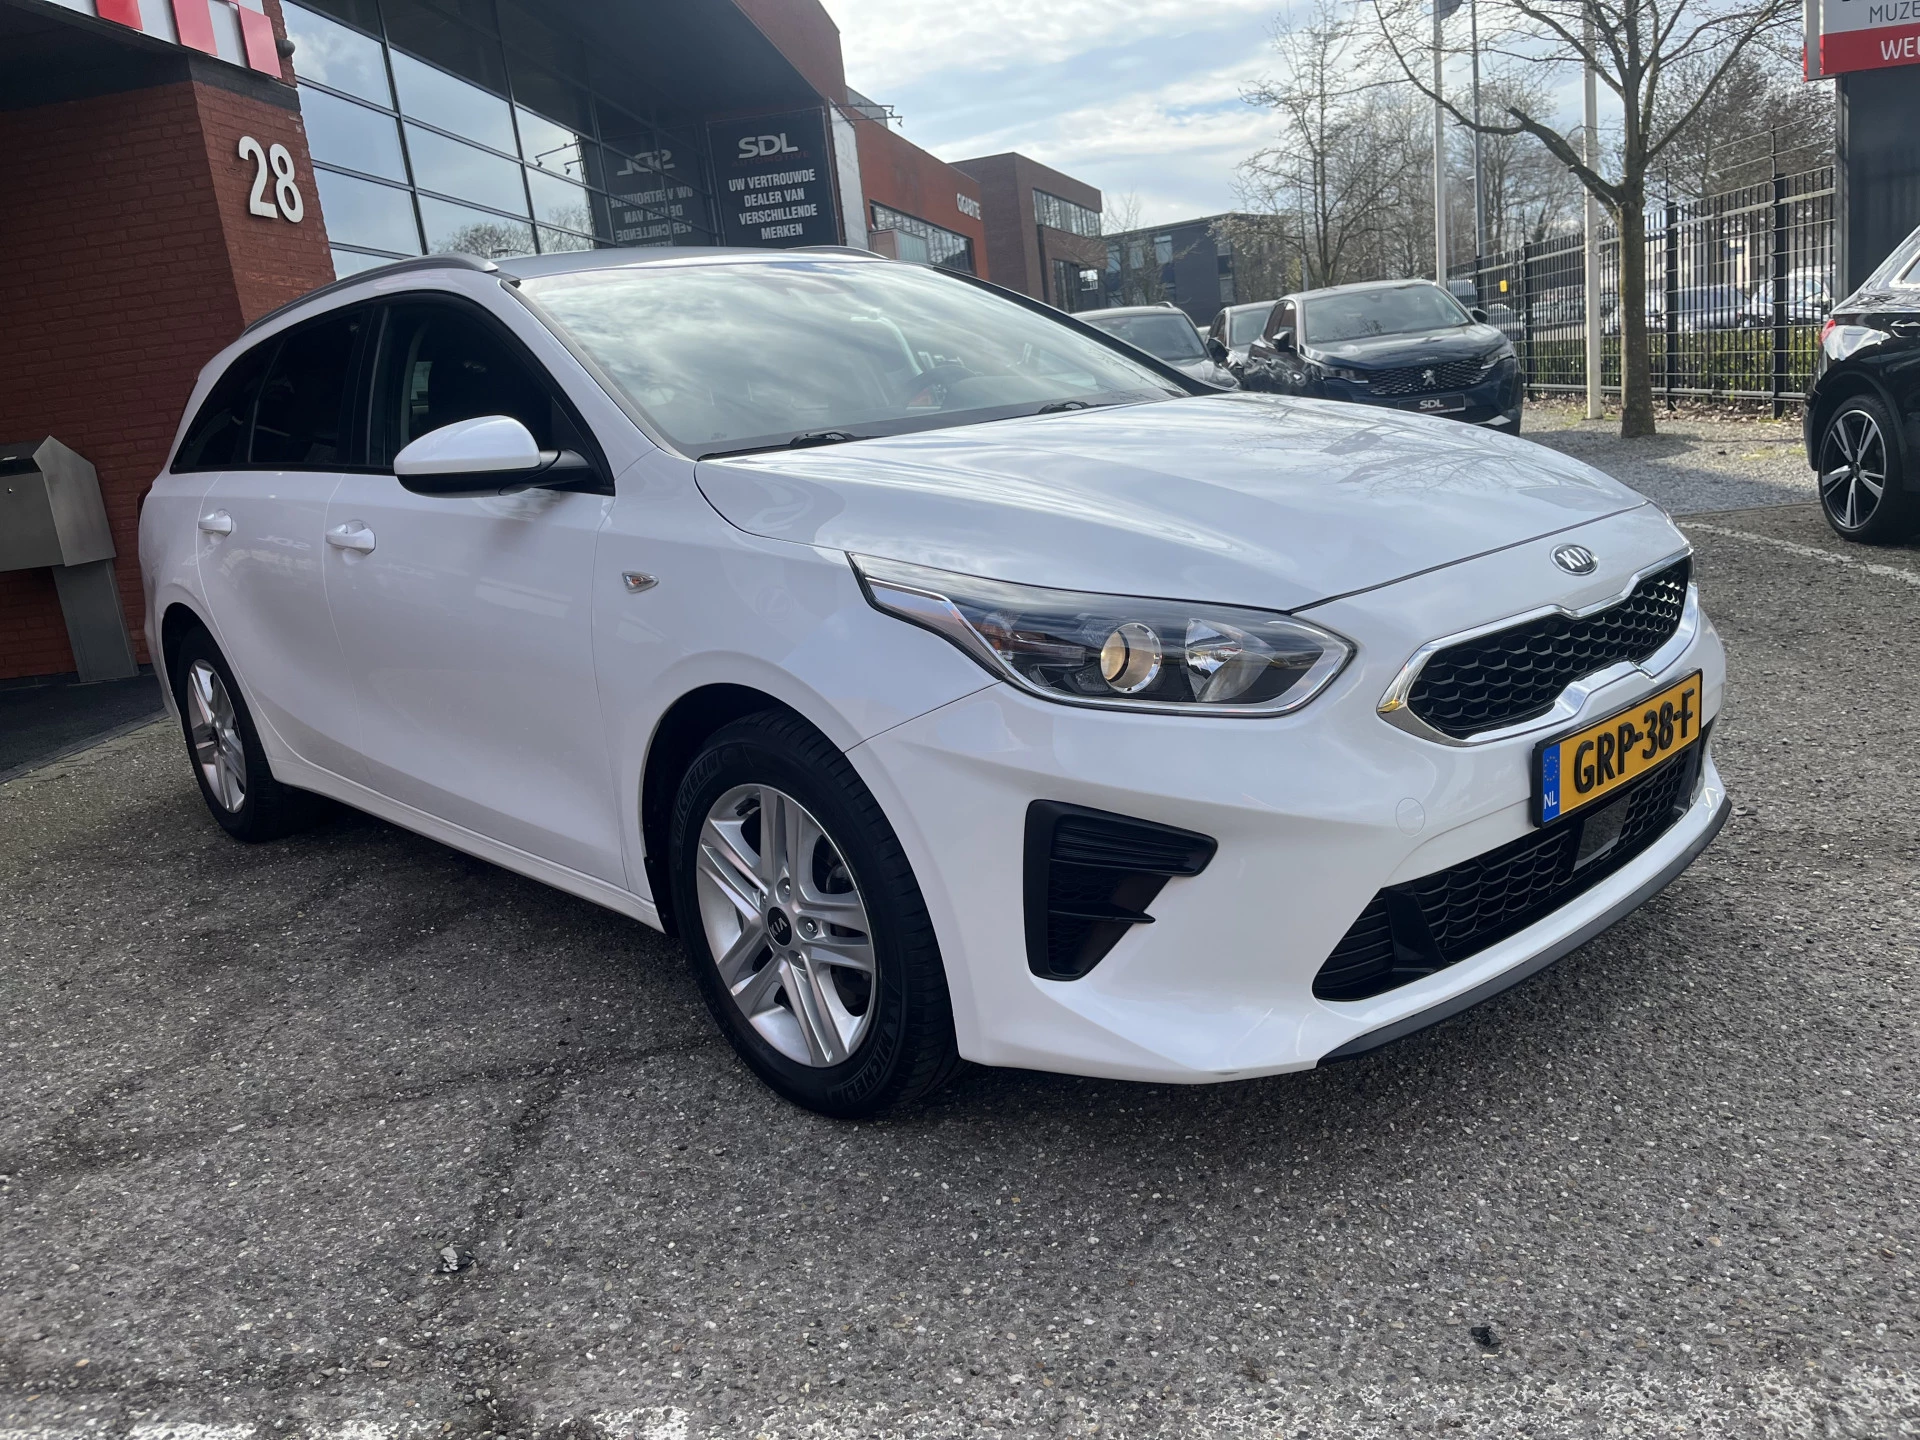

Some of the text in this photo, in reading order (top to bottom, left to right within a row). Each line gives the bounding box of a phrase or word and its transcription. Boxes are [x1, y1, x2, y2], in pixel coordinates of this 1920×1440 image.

[738, 132, 799, 159] SDL
[238, 135, 304, 223] 28
[728, 168, 816, 192] UW VERTROUWDE
[744, 187, 805, 208] DEALER VAN
[739, 203, 818, 225] VERSCHILLENDE
[761, 222, 803, 240] MERKEN
[1419, 398, 1444, 410] SDL
[1556, 547, 1594, 570] KIA
[1573, 687, 1695, 794] GRP-38-F
[1543, 790, 1558, 810] NL
[770, 917, 788, 938] KIA
